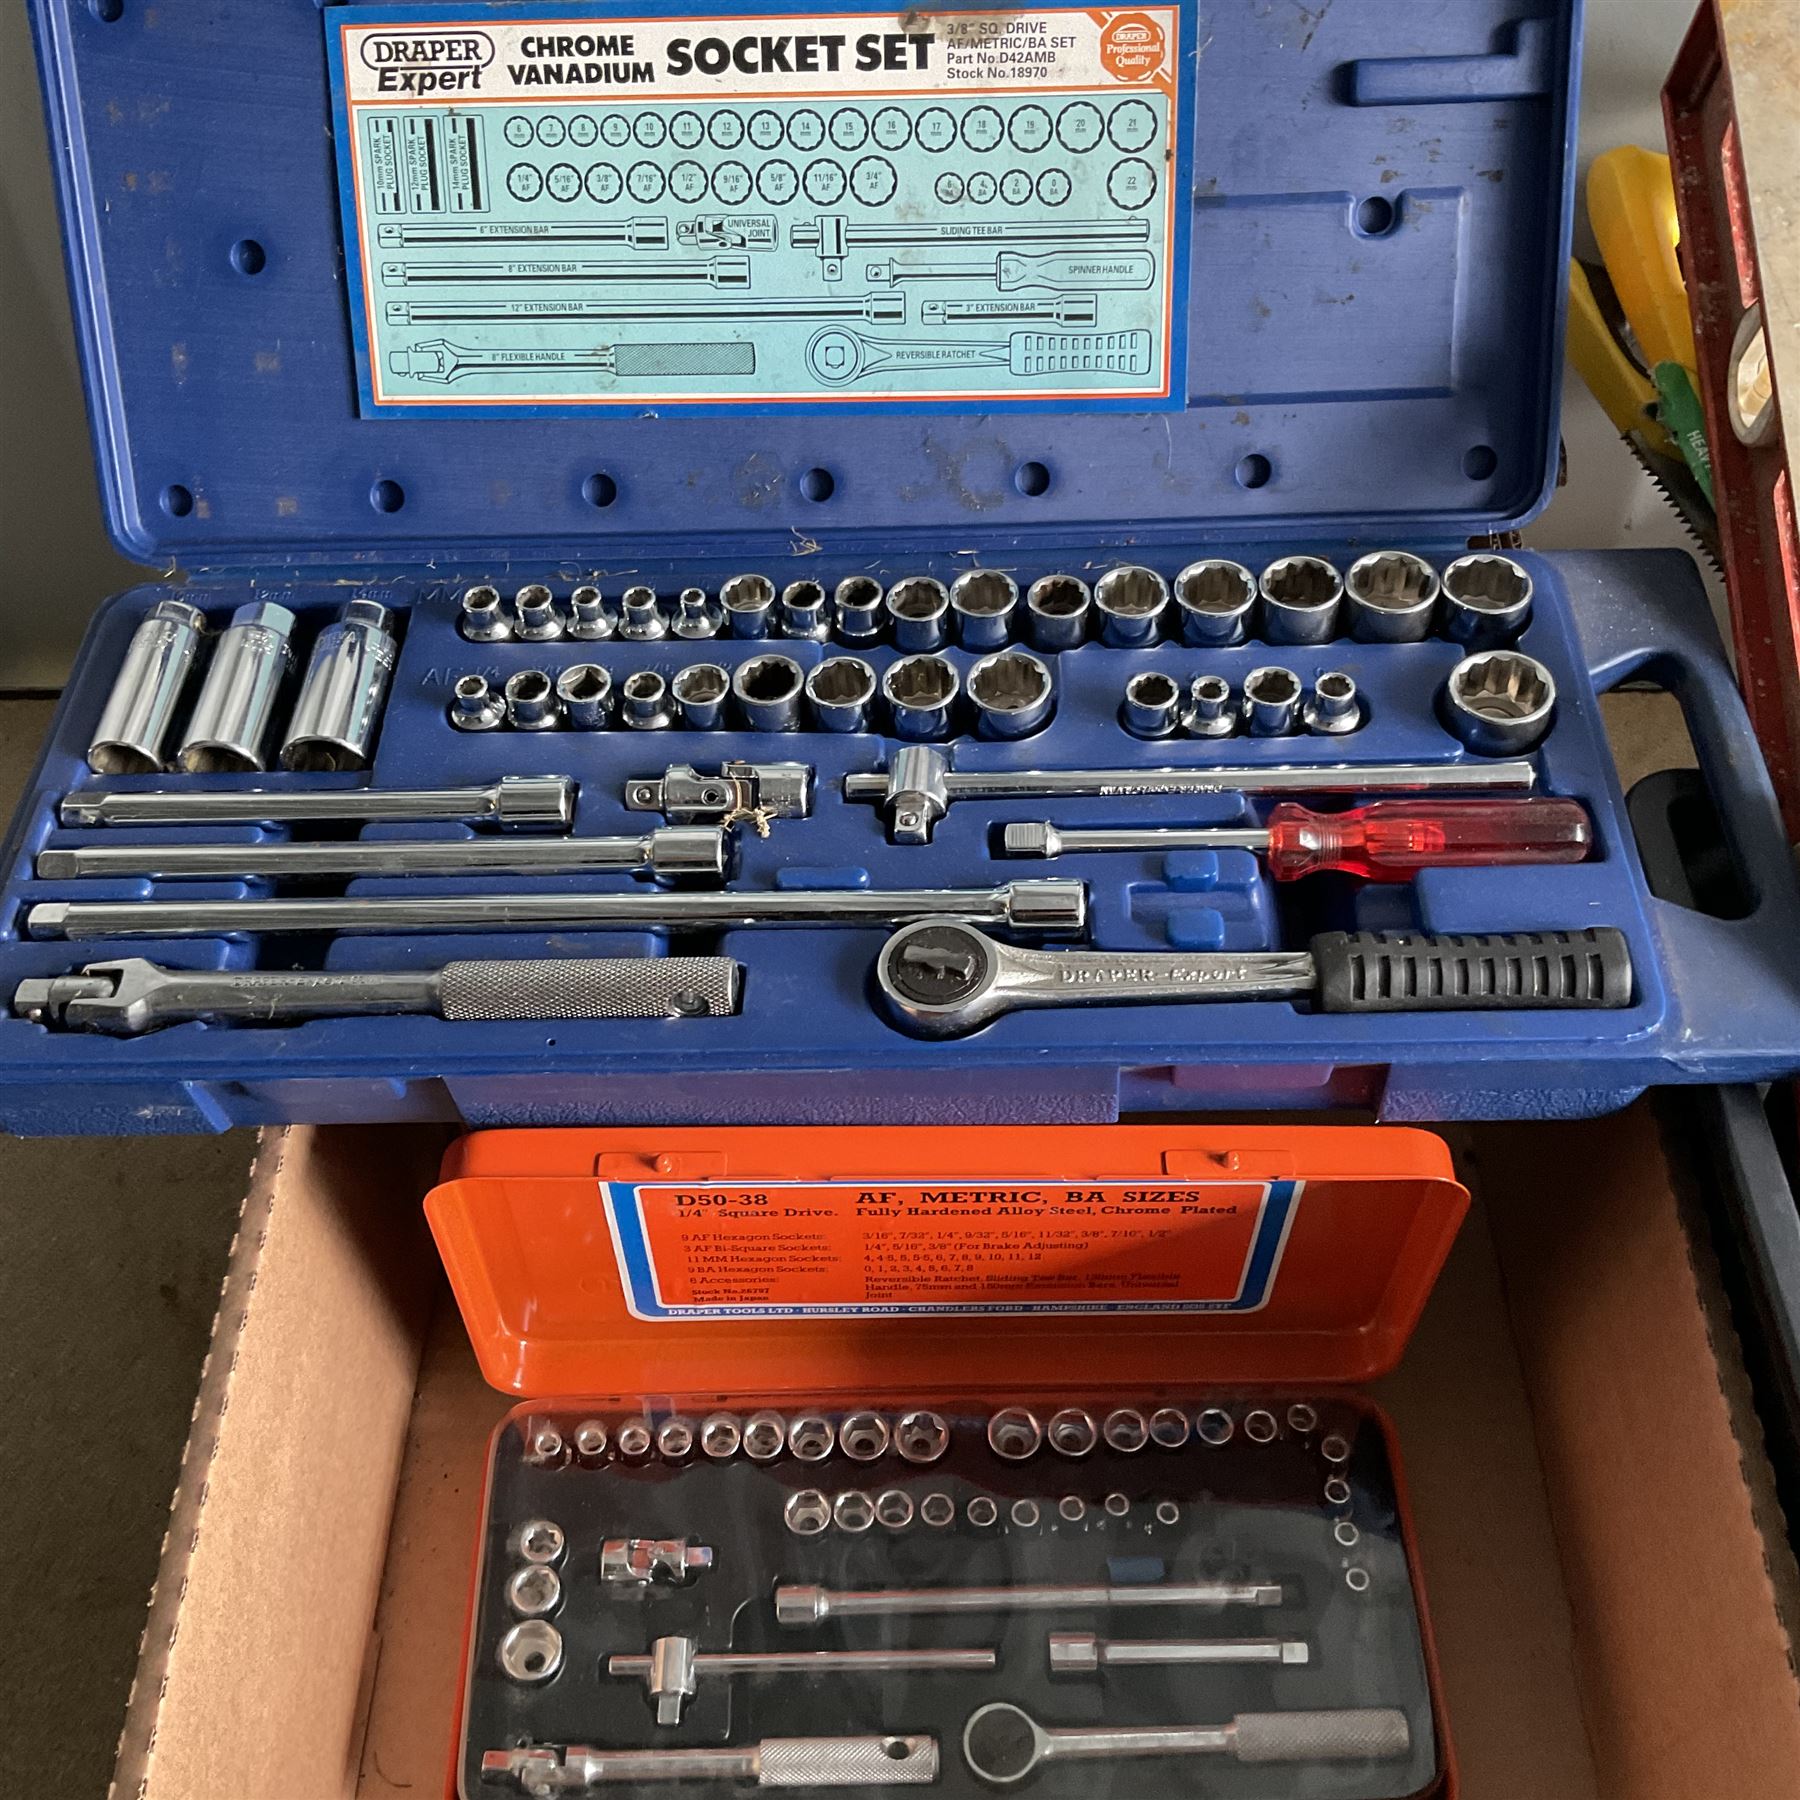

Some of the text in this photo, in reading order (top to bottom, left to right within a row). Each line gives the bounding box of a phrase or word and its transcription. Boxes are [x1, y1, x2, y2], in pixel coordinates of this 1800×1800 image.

[1006, 22, 1047, 34] DRIVE
[520, 35, 635, 58] CHROME
[947, 37, 1076, 50] AF/METRIC/BA SET
[373, 39, 482, 62] DRAPER
[1106, 43, 1160, 54] Professional
[666, 33, 935, 76] SOCKET SET
[947, 53, 974, 64] Part
[1115, 55, 1150, 67] Quality
[507, 62, 655, 85] VANADIUM
[947, 66, 1048, 79] Stock No.18970
[378, 65, 482, 96] Expert
[613, 123, 618, 131] 9
[645, 122, 654, 131] 10
[682, 122, 691, 130] 11
[722, 122, 731, 130] 12
[761, 121, 770, 130] 13
[801, 121, 810, 130] 14
[845, 122, 853, 130] 15
[887, 121, 896, 129] 16
[932, 122, 941, 130] 17
[977, 120, 986, 128] 18
[1026, 120, 1035, 129] 19
[1076, 119, 1085, 128] 20
[1128, 118, 1137, 127] 21
[516, 124, 522, 133] 6
[548, 124, 554, 132] 7
[580, 123, 586, 132] 8
[373, 137, 385, 189] 10mm SPARK
[382, 135, 394, 189] PLUG SOCKET
[408, 139, 419, 190] 12mm SPARK
[417, 136, 429, 190] PLUG SOCKET
[449, 138, 460, 189] 14mm SPARK
[458, 135, 470, 190] PLUG SOCKET
[869, 181, 878, 189] AF
[1127, 176, 1136, 185] 22
[561, 184, 570, 192] AF
[600, 184, 609, 192] AF
[643, 184, 652, 192] AF
[685, 183, 694, 191] AF
[730, 184, 738, 192] AF
[774, 183, 783, 191] AF
[822, 183, 830, 191] AF
[727, 219, 771, 228] UNIVERSAL
[489, 225, 533, 234] EXTENSION
[533, 225, 549, 234] BAR
[748, 229, 771, 237] JOINT
[940, 226, 1003, 235] SLIDING TEE BAR
[518, 264, 560, 273] EXTENSION
[561, 263, 577, 272] BAR
[1068, 264, 1134, 274] SPINNER HANDLE
[524, 303, 567, 312] EXTENSION
[568, 303, 583, 311] BAR
[976, 303, 1019, 312] EXTENSION
[1019, 303, 1036, 311] BAR
[501, 352, 534, 361] FLEXIBLE
[535, 352, 566, 361] HANDLE
[896, 350, 976, 359] REVERSIBLE RATCHET
[674, 1194, 769, 1206] D50-38
[856, 1191, 1200, 1206] AF, METRIC, BA SIZES
[679, 1208, 838, 1219] 1/4" Square Drive.
[856, 1205, 1237, 1217] Fully Hardened Alloy Steel, Chrome Plated
[713, 1233, 771, 1242] Hexagon
[715, 1244, 776, 1253] Bi-Square
[954, 1242, 979, 1251] (For
[983, 1242, 1019, 1250] Brake
[1022, 1241, 1089, 1250] Adjusting)
[730, 1255, 786, 1264] Hexagon
[718, 1266, 775, 1274] Hexagon
[669, 1307, 721, 1315] DRAPER
[723, 1307, 765, 1315] TOOLS
[768, 1306, 793, 1314] LTD
[862, 1305, 900, 1313] ROAD
